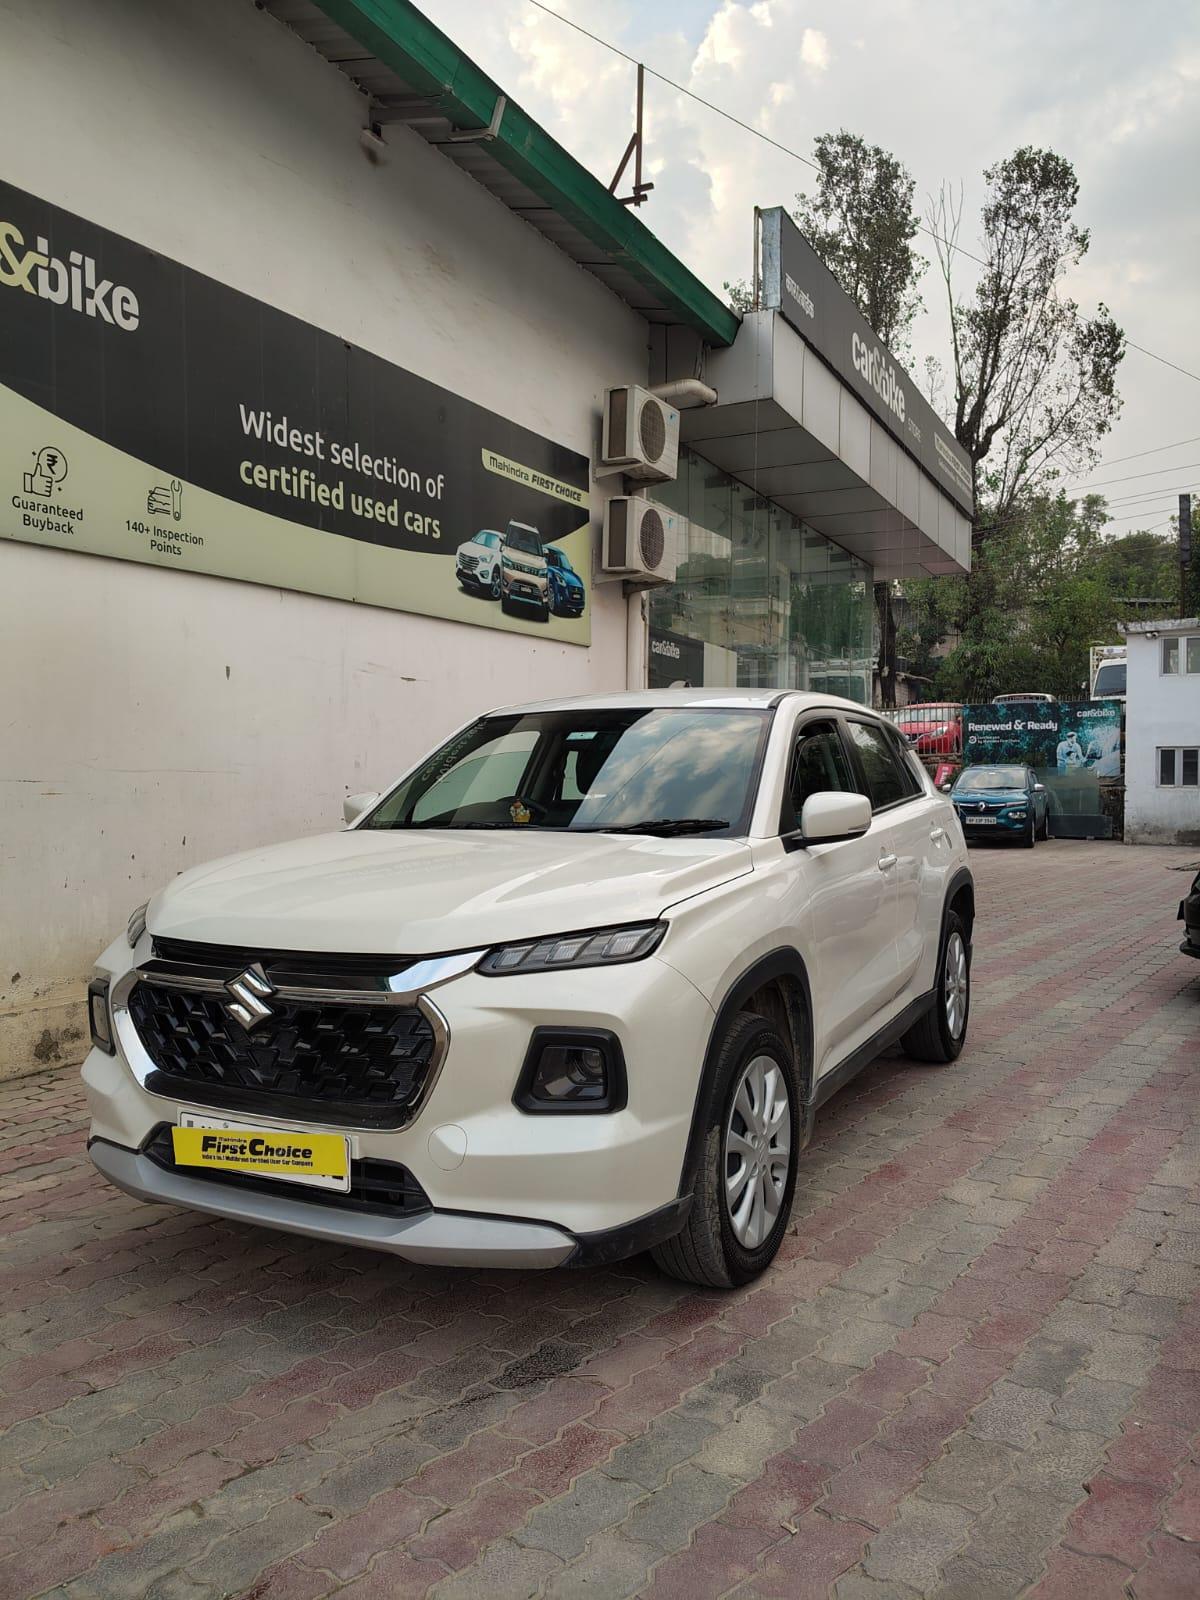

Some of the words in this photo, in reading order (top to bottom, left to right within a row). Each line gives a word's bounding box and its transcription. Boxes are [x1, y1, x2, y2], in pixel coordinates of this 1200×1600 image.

[852, 332, 906, 423] car&bike
[239, 404, 325, 460] Widest
[330, 442, 421, 493] selection
[426, 474, 445, 500] of
[489, 456, 529, 481] Mahindra
[531, 474, 555, 491] FIRST
[555, 484, 582, 502] CHOICE
[12, 495, 84, 521] Guaranteed
[239, 460, 344, 511] certified
[351, 493, 398, 527] used
[404, 511, 441, 539] cars
[23, 513, 74, 535] Buyback
[126, 520, 151, 535] 140+
[153, 525, 204, 546] Inspection
[150, 540, 182, 556] Points
[651, 640, 680, 659] car&bike
[968, 721, 1012, 732] Renewed
[1014, 719, 1026, 730] &
[1027, 720, 1058, 732] Ready
[1076, 708, 1116, 718] car&bike
[202, 1135, 247, 1155] First
[249, 1138, 313, 1159] Choice
